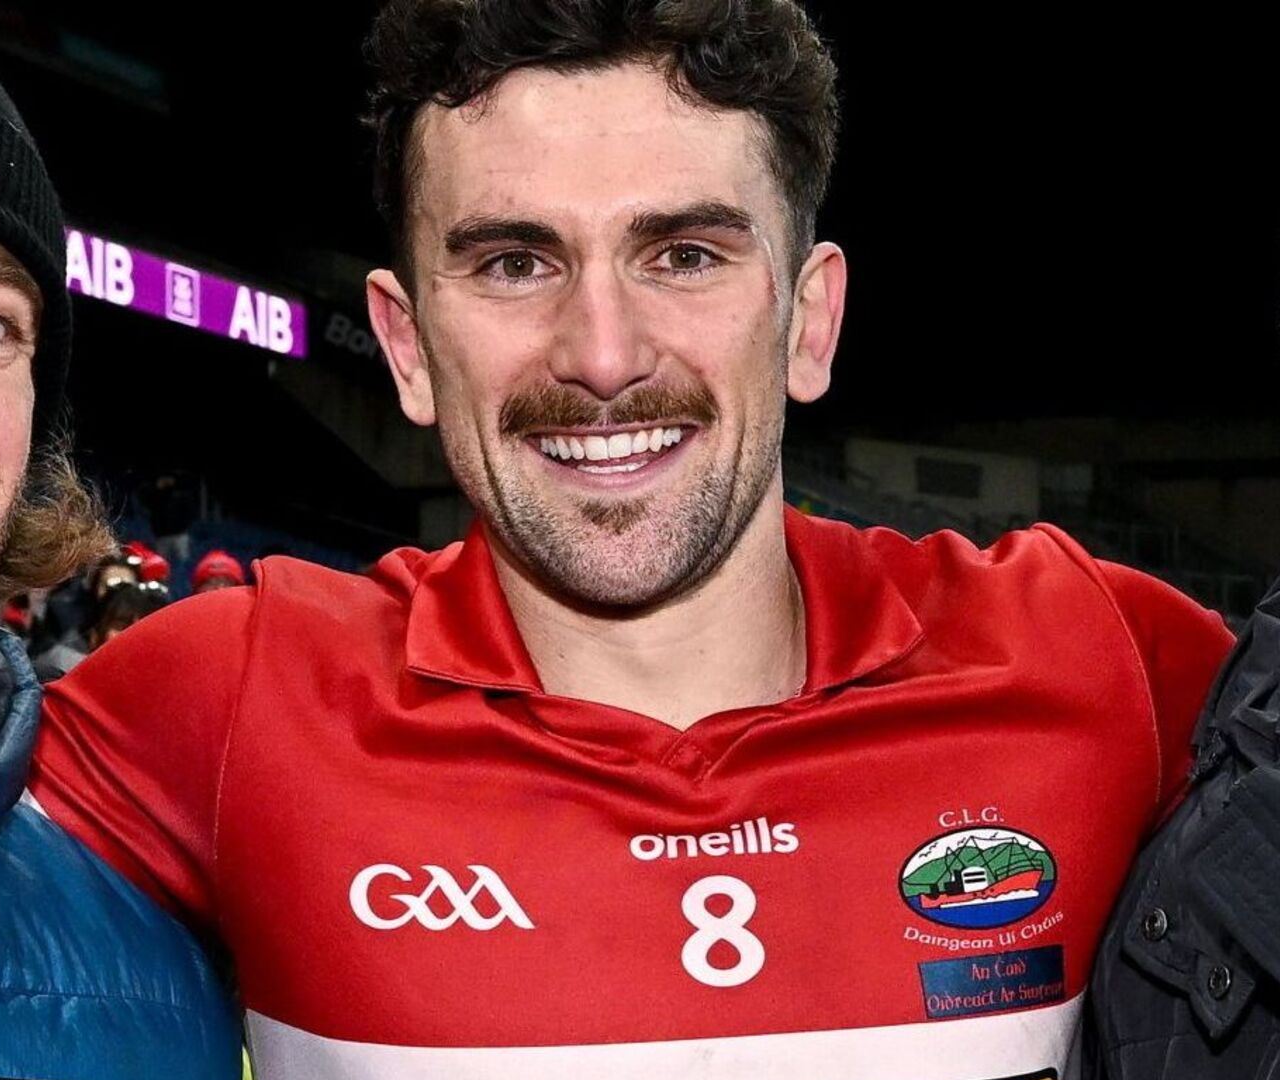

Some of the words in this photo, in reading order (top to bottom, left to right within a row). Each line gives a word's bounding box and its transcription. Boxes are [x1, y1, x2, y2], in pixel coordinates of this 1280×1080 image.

[66, 230, 135, 306] AIB
[228, 285, 294, 354] AIB
[349, 863, 536, 931] GAA
[680, 874, 766, 988] 8
[903, 926, 994, 951] Daingean
